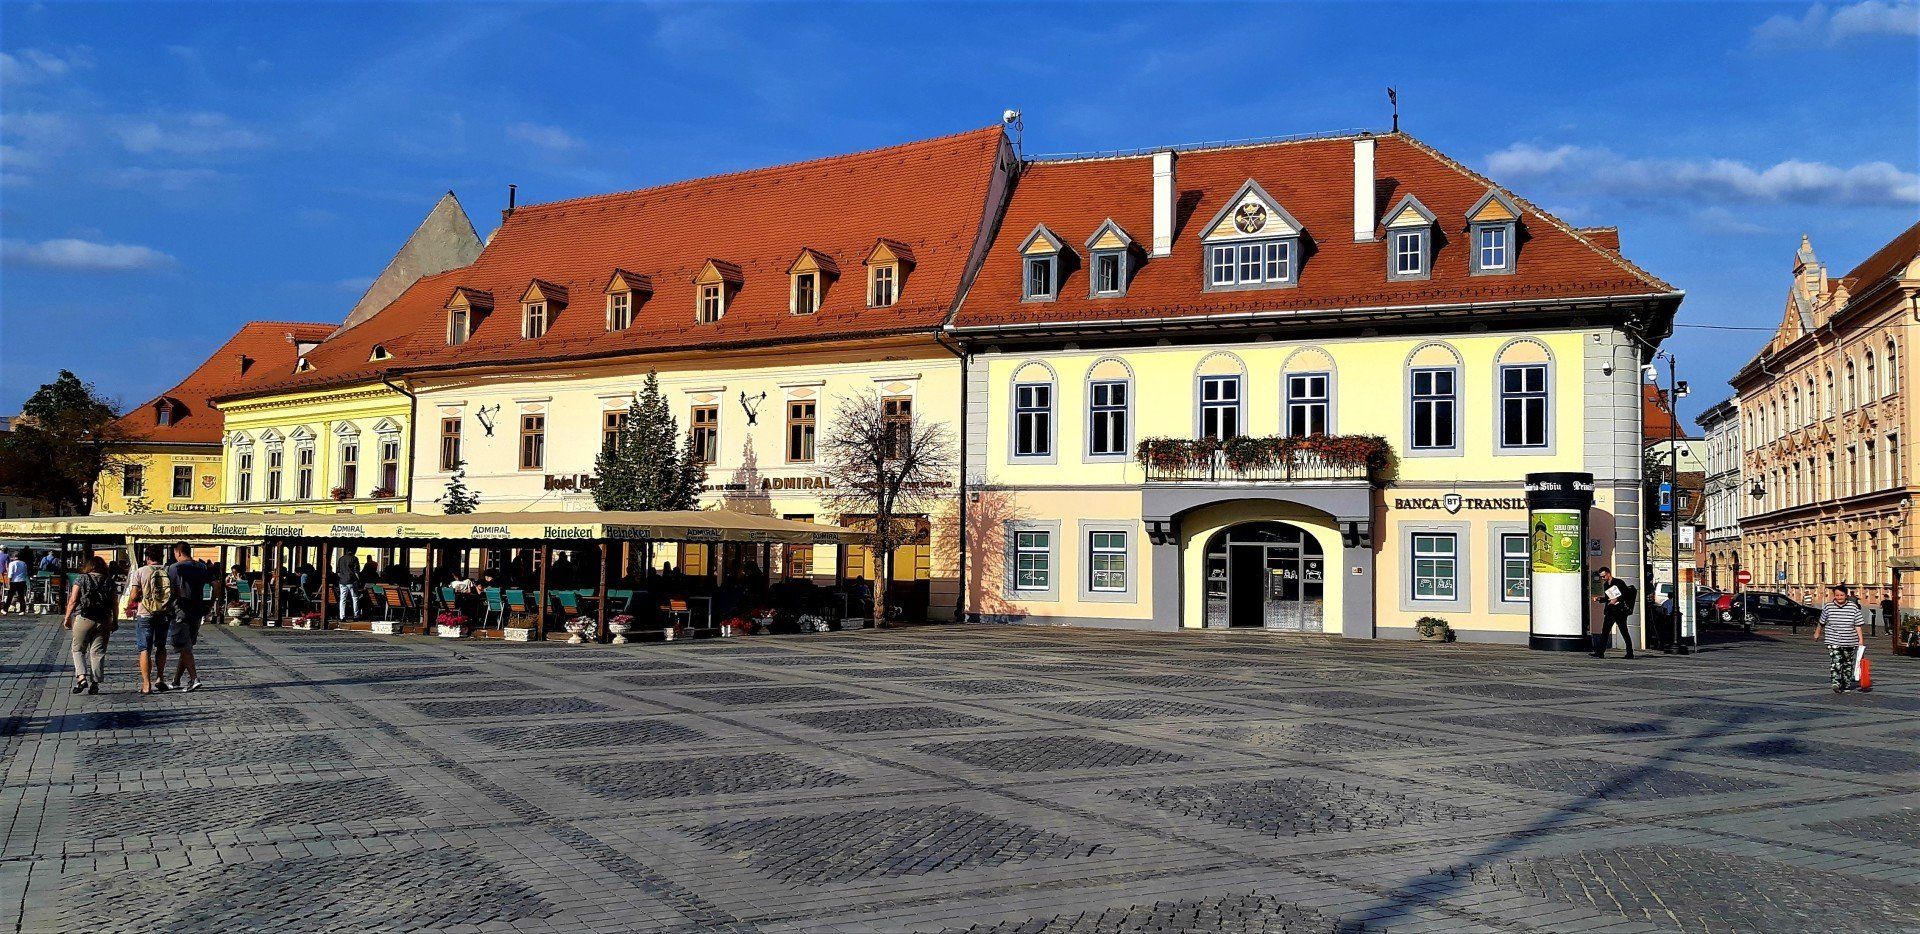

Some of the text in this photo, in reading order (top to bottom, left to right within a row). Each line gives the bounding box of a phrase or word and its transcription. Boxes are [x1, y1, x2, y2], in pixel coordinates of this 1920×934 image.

[761, 477, 835, 490] ADMIRAL
[1540, 480, 1562, 491] Sibiu
[168, 503, 188, 511] HOTEL
[1395, 498, 1441, 509] BANCA
[212, 523, 247, 535] Heineken
[265, 524, 303, 536] Heineken
[330, 525, 365, 533] ADMIRAL
[472, 525, 511, 534] ADMIRAL
[544, 526, 593, 538] Heineken
[606, 526, 651, 538] Heineken
[687, 528, 722, 537] ADMIRAL
